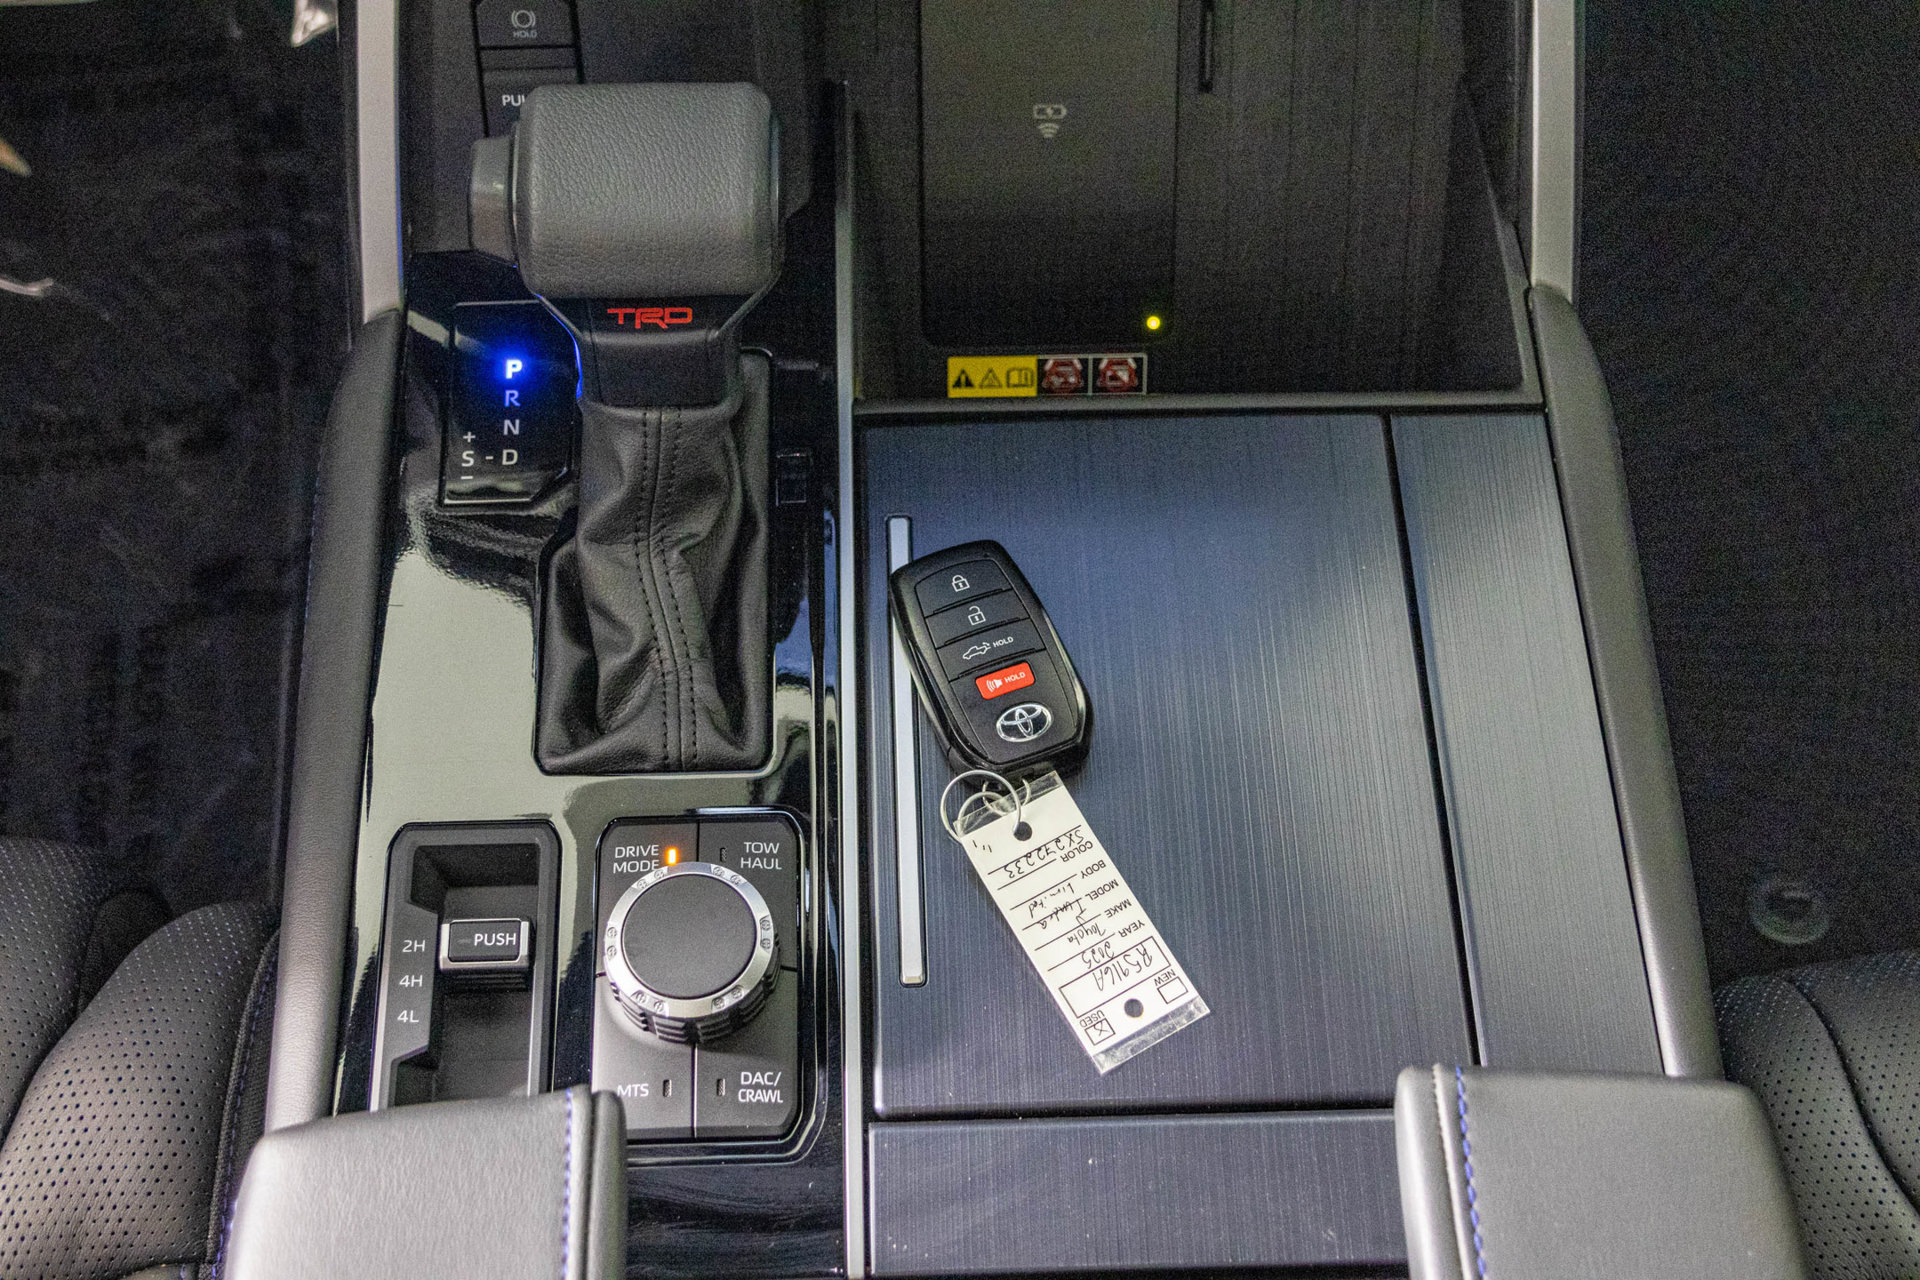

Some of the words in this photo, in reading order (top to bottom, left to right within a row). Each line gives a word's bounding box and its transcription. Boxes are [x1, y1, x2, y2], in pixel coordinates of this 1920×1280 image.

[513, 30, 537, 38] HOLD
[607, 307, 693, 329] TRD
[505, 359, 523, 379] P
[504, 390, 520, 407] R
[503, 419, 520, 435] N
[461, 451, 475, 467] S
[502, 449, 518, 465] D
[993, 636, 1014, 648] HOLD
[1004, 671, 1026, 684] HOLD
[614, 845, 659, 859] DRIVE
[743, 841, 780, 854] TOW
[1060, 840, 1094, 863] COLOR
[613, 860, 659, 874] MODE
[740, 857, 782, 870] HAUL
[1080, 859, 1106, 879] BODY
[1085, 879, 1120, 901] MODEL
[1105, 898, 1132, 919] MAKE
[1067, 914, 1106, 944] Toyota
[1118, 920, 1146, 938] YEAR
[402, 940, 426, 953] 2H
[474, 933, 517, 946] PUSH
[1081, 941, 1115, 970] 2025
[399, 975, 423, 988] 4H
[1153, 968, 1176, 987] NEW
[397, 1010, 419, 1023] 4L
[1079, 1010, 1105, 1028] USED
[740, 1071, 782, 1087] DAC/
[617, 1083, 649, 1097] MTS
[738, 1088, 783, 1103] CRAWL
